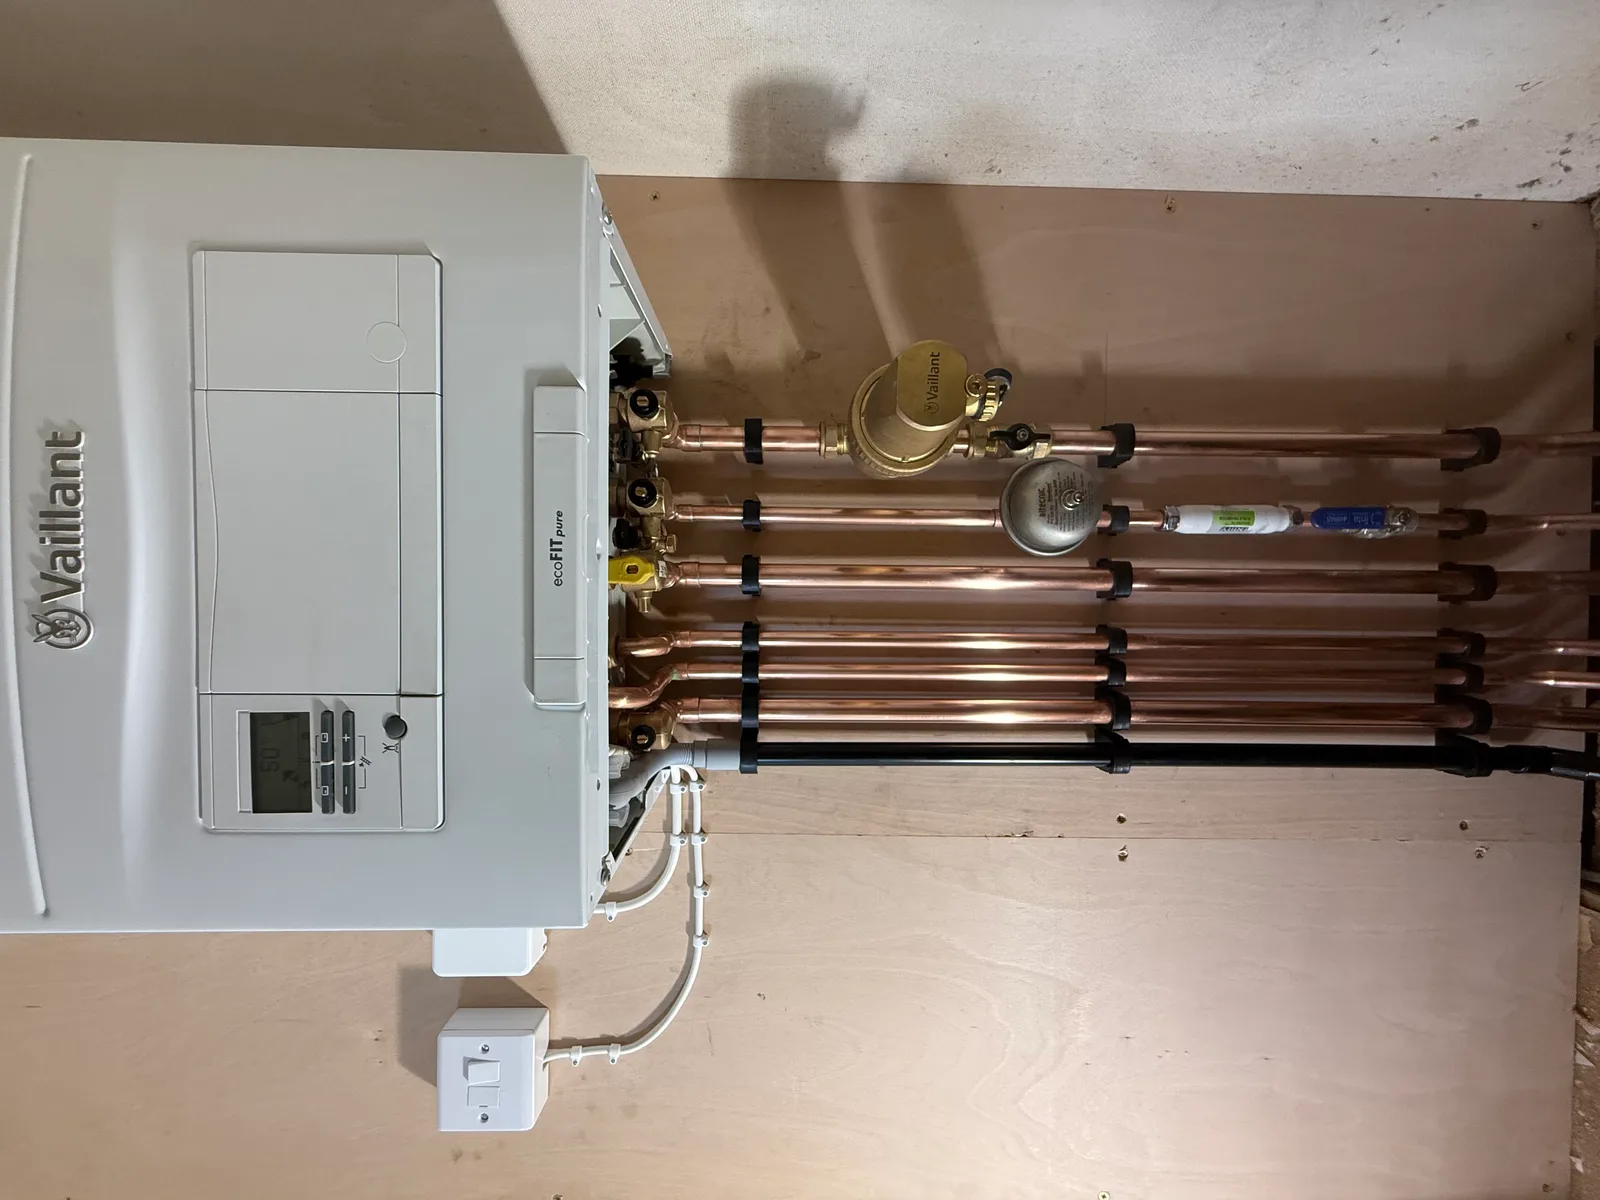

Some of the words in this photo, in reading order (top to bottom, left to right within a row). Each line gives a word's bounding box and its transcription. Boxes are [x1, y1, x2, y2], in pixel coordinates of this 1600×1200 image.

[927, 351, 940, 401] Vaillant
[40, 431, 85, 603] Vaillant
[555, 510, 566, 537] pure
[549, 538, 563, 587] ecoFIT
